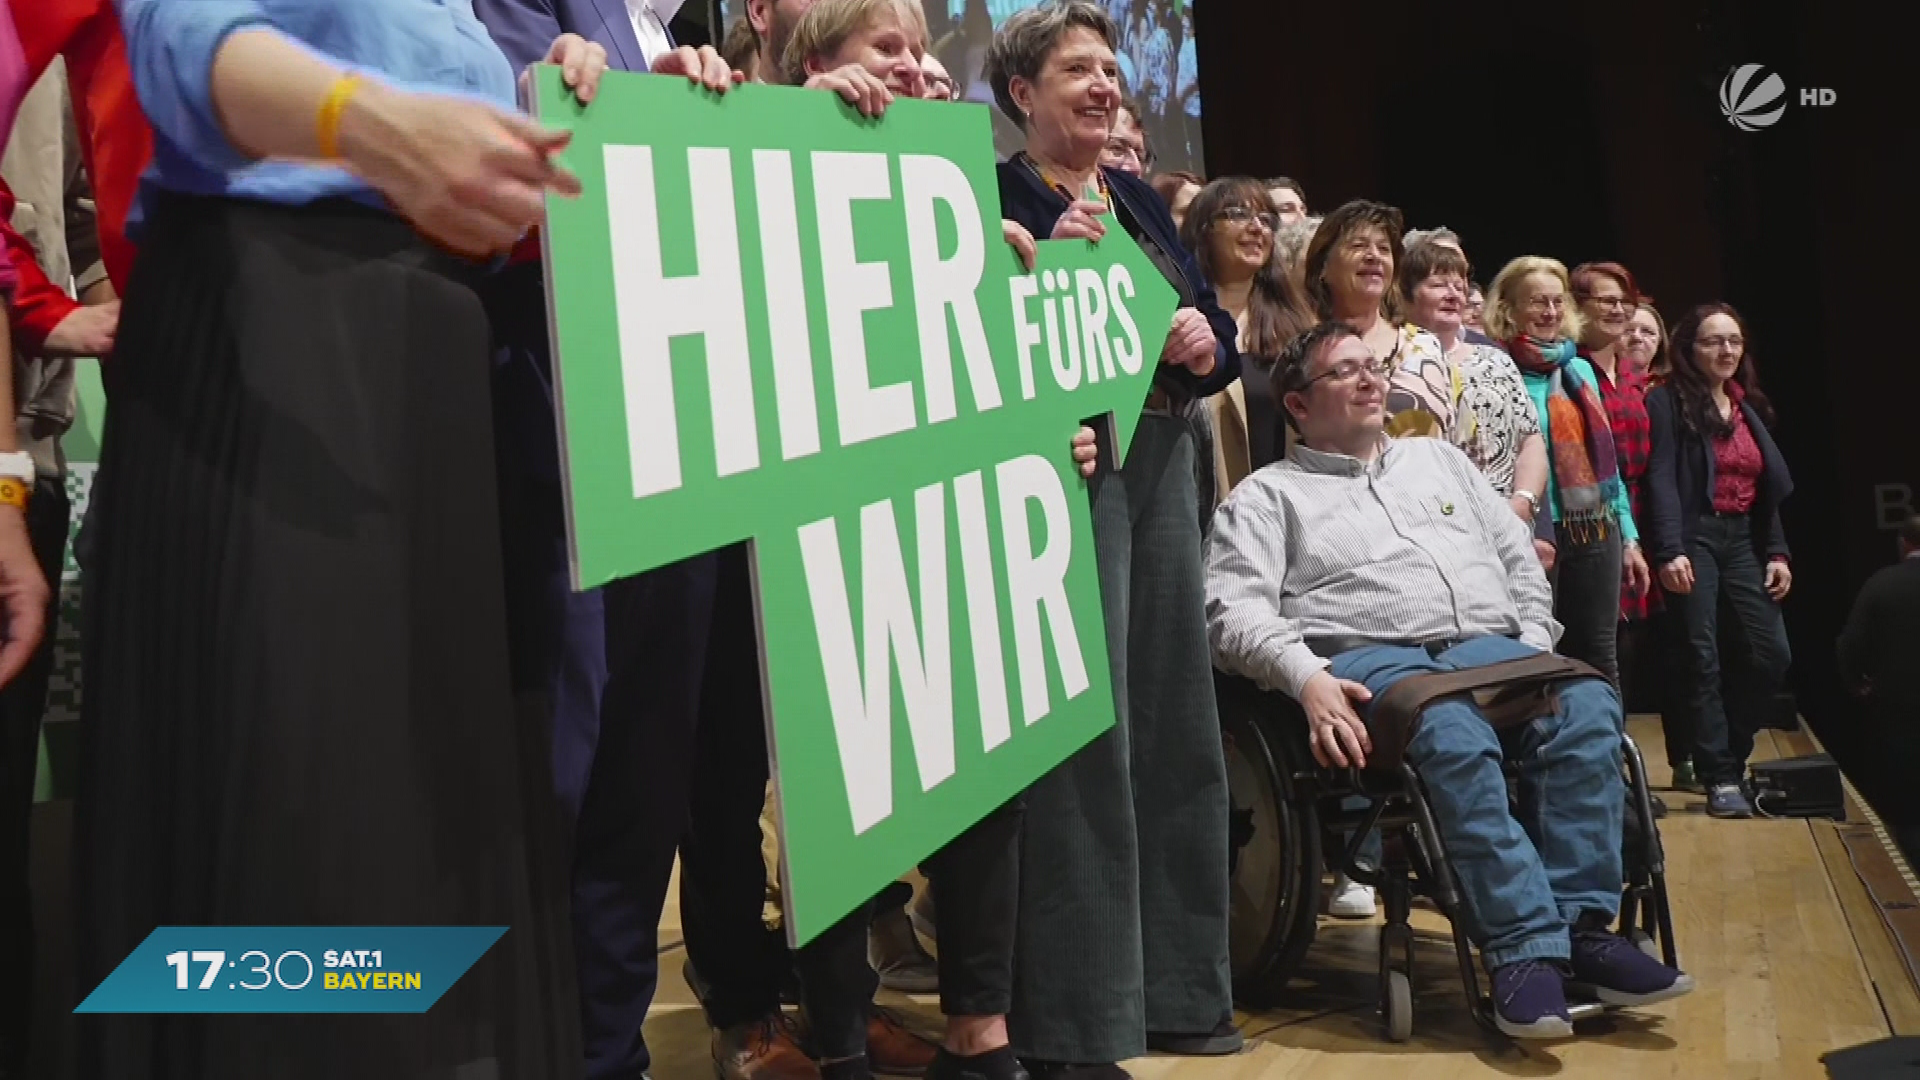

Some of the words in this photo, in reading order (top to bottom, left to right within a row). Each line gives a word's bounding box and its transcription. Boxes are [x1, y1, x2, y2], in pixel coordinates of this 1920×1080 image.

[602, 144, 1003, 499] HIER
[1009, 262, 1144, 401] FÜRS
[797, 454, 1090, 836] WIR
